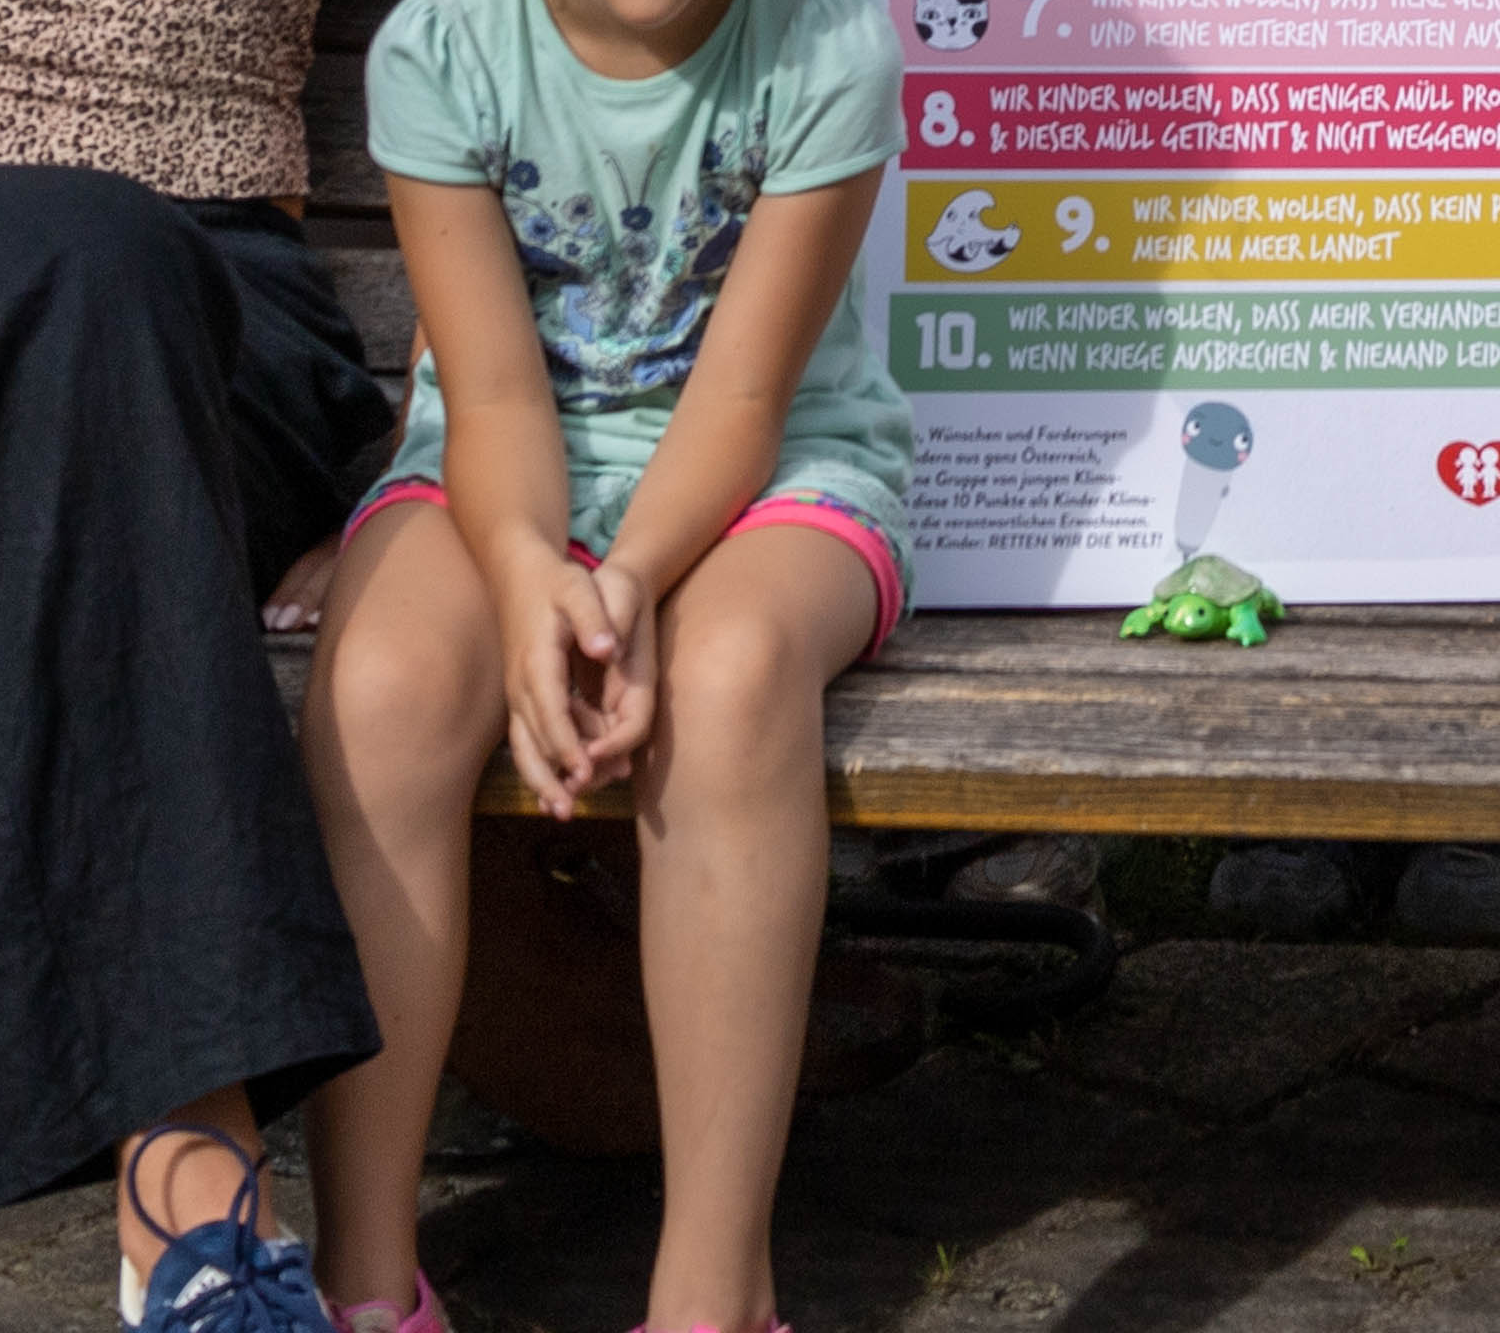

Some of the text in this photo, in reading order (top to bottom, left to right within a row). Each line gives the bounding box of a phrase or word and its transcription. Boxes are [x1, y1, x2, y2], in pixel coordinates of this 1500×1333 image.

[1090, 18, 1136, 49] UND
[1145, 19, 1211, 49] KEINE
[1218, 18, 1329, 49] WEITEREN
[1334, 18, 1456, 49] TIERARTEN
[989, 84, 1033, 112] WIR
[1038, 83, 1121, 113] KINDER
[1125, 82, 1222, 117] WOLLEN,
[1231, 82, 1280, 114] DASS
[1287, 82, 1391, 114] WENIGER
[1394, 79, 1454, 112] MÜLL
[920, 91, 974, 146] 8.
[990, 121, 1009, 154] &
[1016, 121, 1091, 153] DIESER
[1094, 118, 1155, 151] MÜLL
[1161, 120, 1289, 153] GETRENNT
[1290, 121, 1309, 153] &
[1316, 120, 1385, 154] NICHT
[1055, 196, 1110, 253] 9.
[1132, 194, 1176, 222] WIR
[1180, 194, 1263, 224] KINDER
[1267, 193, 1365, 227] WOLLEN,
[1373, 192, 1422, 224] DASS
[1430, 192, 1483, 224] KEIN
[1131, 230, 1402, 263] MEHR IM MEER LANDET
[1008, 303, 1051, 331] WIR
[1057, 302, 1139, 333] KINDER
[1144, 301, 1242, 336] WOLLEN,
[1251, 300, 1301, 332] DASS
[1308, 302, 1375, 330] MEHR
[916, 312, 991, 369] 10.
[1007, 342, 1078, 373] WENN
[1086, 340, 1165, 372] KRIEGE
[1171, 339, 1311, 374] AUSBRECHEN
[1319, 340, 1338, 373] &
[1345, 339, 1449, 371] NIEMAND
